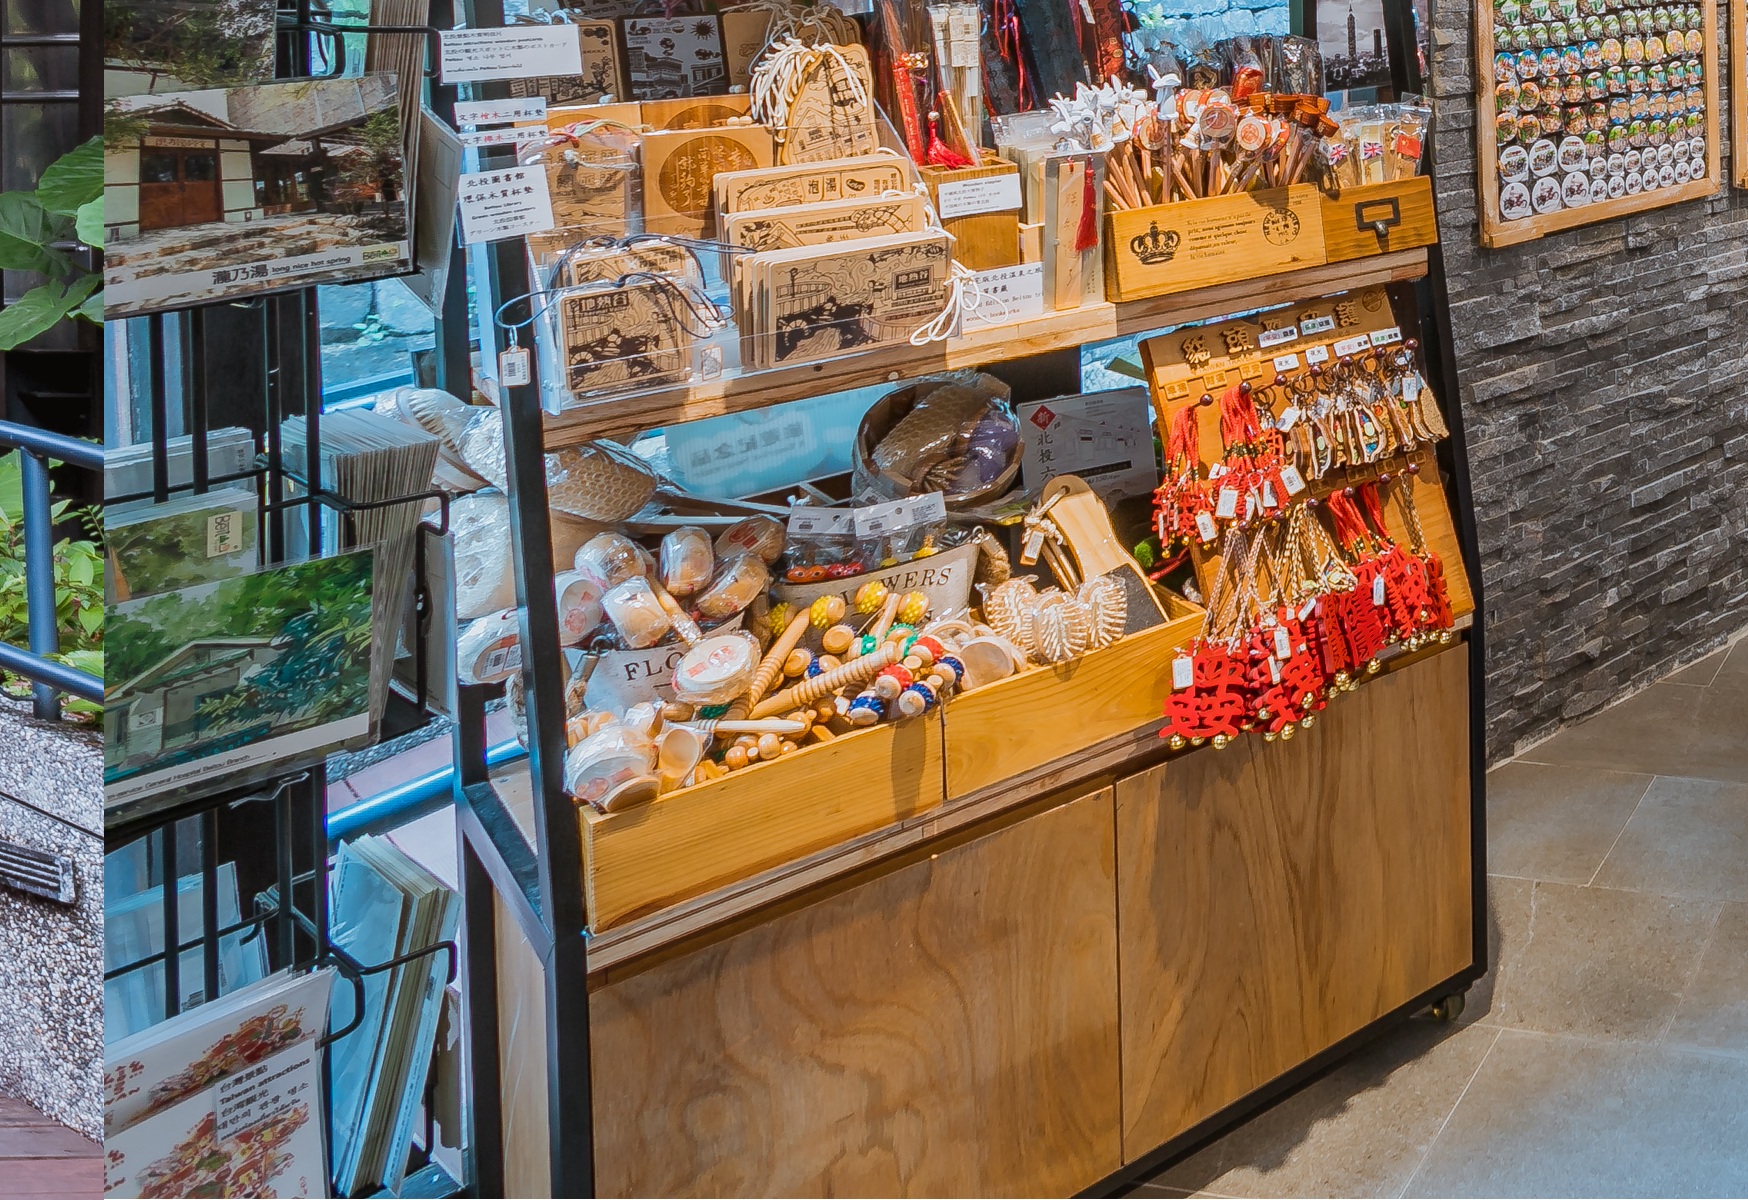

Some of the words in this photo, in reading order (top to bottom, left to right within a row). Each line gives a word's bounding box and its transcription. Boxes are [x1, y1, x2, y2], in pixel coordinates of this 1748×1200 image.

[467, 172, 525, 188] 北投圖書館
[464, 186, 534, 203] 環保木質杯墊
[272, 265, 291, 274] long
[293, 262, 309, 271] nice
[311, 260, 325, 268] hot
[326, 256, 351, 267] spring
[213, 264, 268, 285] 瀧乃湯
[1036, 411, 1051, 427] 新
[145, 776, 173, 789] General
[173, 767, 202, 780] Hospital
[219, 1084, 256, 1105] Taiwan
[257, 1058, 311, 1087] attractions
